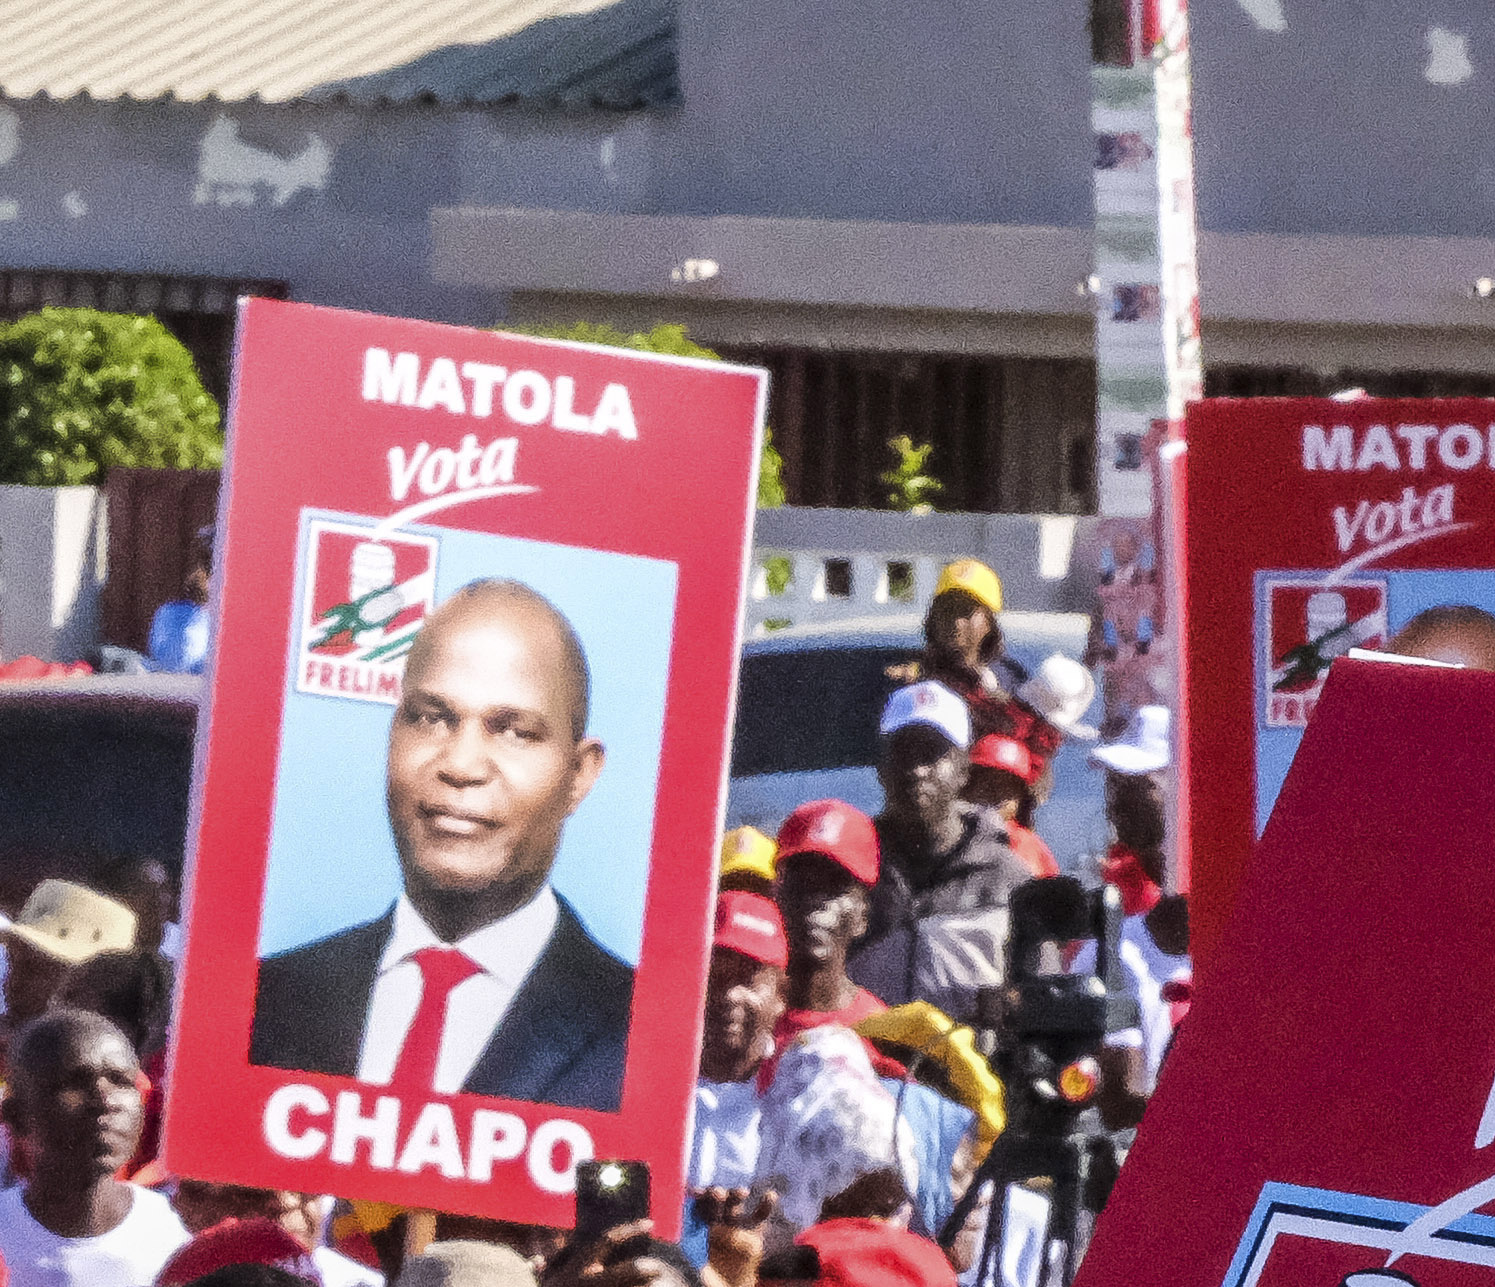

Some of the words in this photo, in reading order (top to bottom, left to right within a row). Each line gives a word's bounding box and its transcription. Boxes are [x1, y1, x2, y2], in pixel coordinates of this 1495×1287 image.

[361, 346, 639, 441] MATOLA
[386, 433, 520, 501] Vota
[1332, 483, 1456, 551] Vota
[260, 1080, 596, 1196] CHAPO
